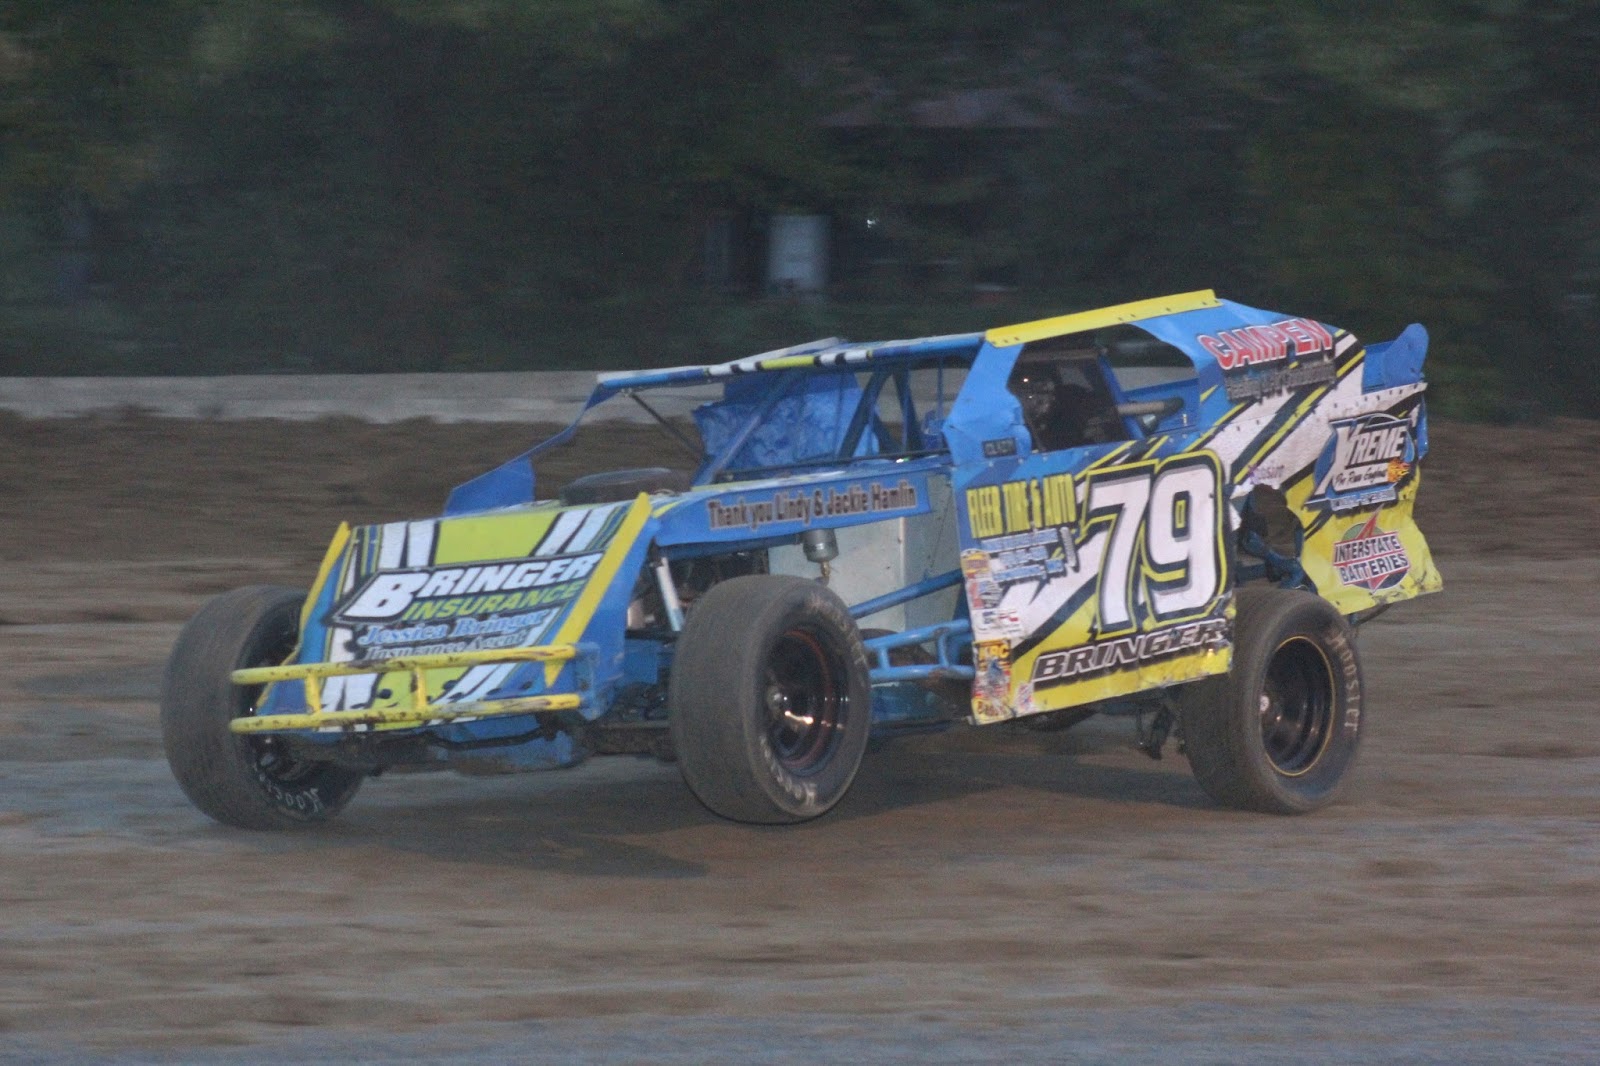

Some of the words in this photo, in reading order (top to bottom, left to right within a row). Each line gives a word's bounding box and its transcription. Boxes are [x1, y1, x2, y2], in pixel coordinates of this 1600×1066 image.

[1197, 318, 1333, 370] CAMPEN
[707, 496, 747, 530] Thank
[747, 502, 773, 532] you
[826, 484, 869, 517] Jackie
[871, 479, 916, 513] Hamlin
[1087, 460, 1222, 628] 79
[1334, 533, 1401, 564] INTERSTATE
[1339, 553, 1409, 583] BATTERIES
[343, 553, 603, 618] BRINGER
[402, 579, 587, 622] INSURANCE
[357, 622, 448, 646] Jessica
[450, 608, 550, 636] Bringer
[1033, 621, 1225, 683] BRINGER
